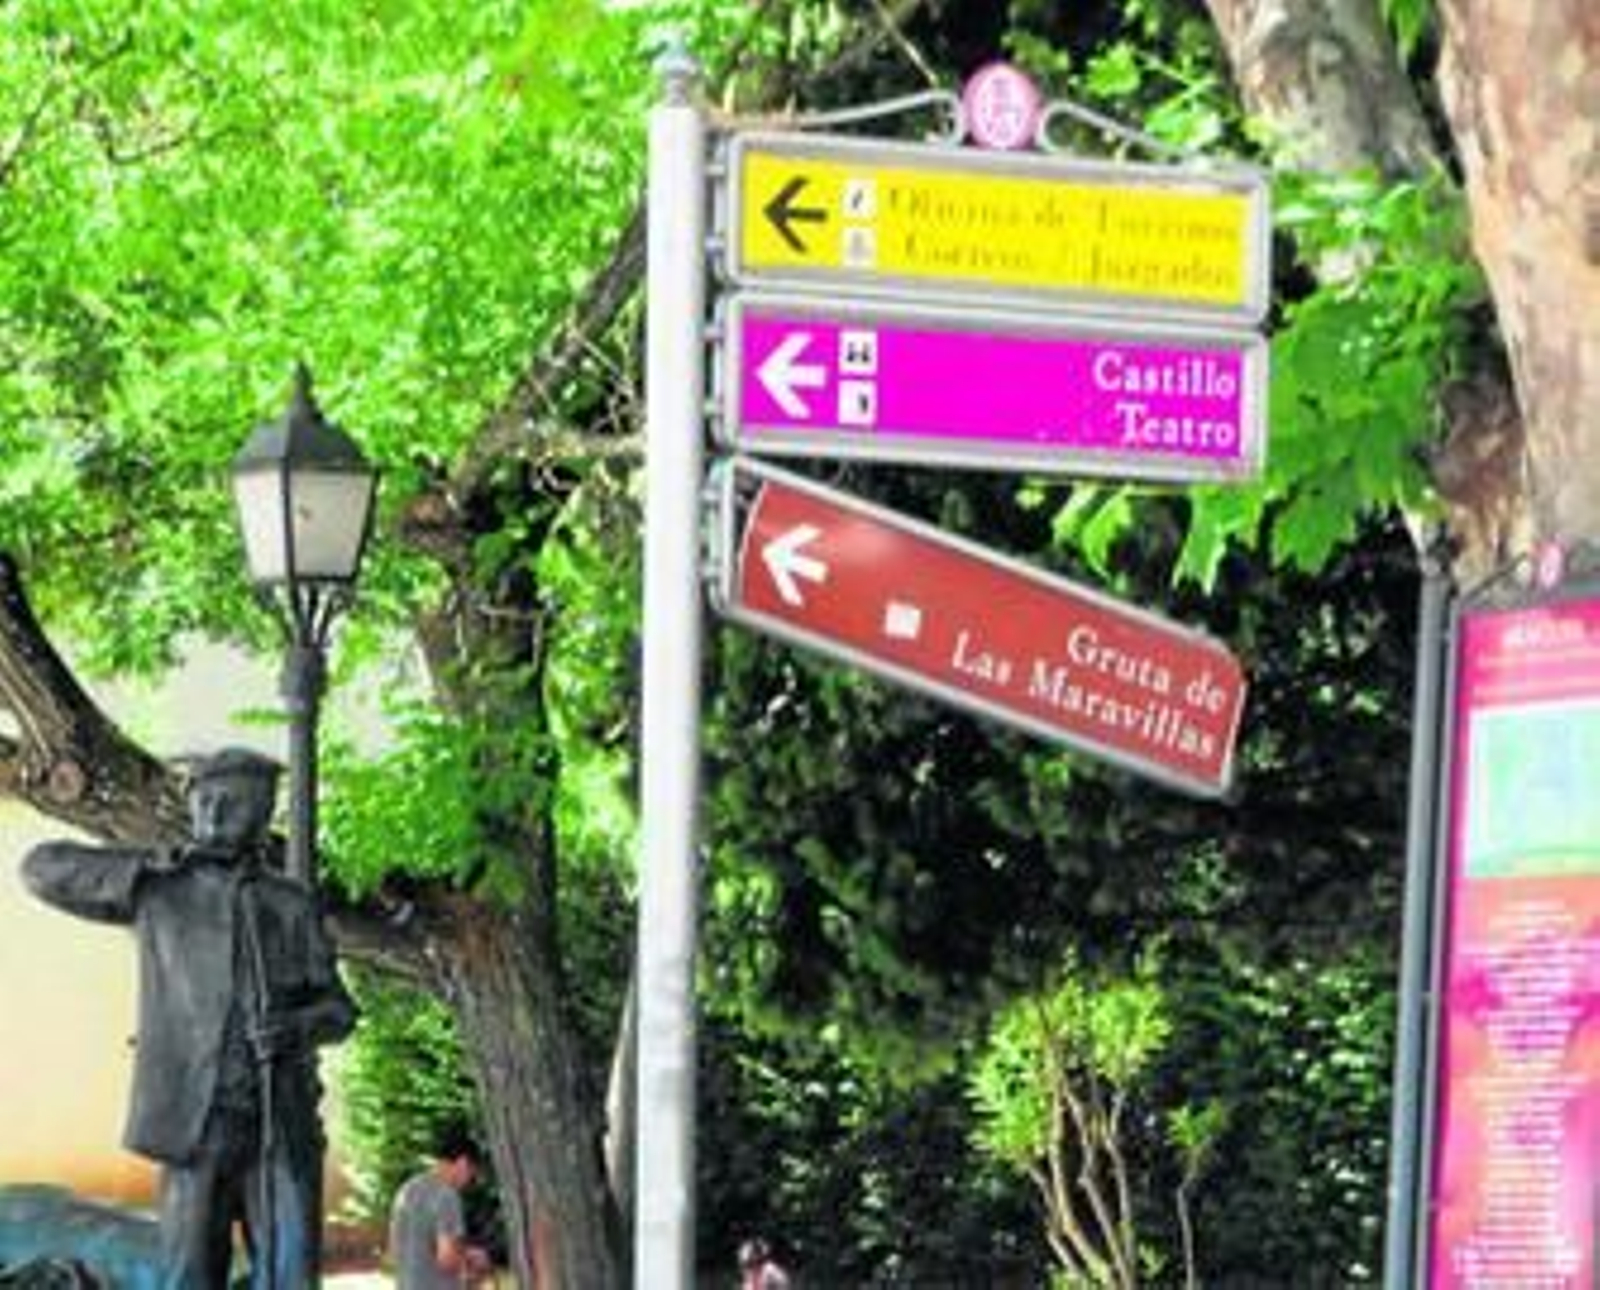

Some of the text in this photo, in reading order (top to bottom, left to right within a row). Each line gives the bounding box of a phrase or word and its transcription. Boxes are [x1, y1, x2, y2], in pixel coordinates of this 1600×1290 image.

[1092, 350, 1237, 400] Castillo
[1115, 402, 1237, 449] Teatro
[951, 629, 1217, 760] Las Maravillas
[1066, 624, 1227, 714] Gruta de
